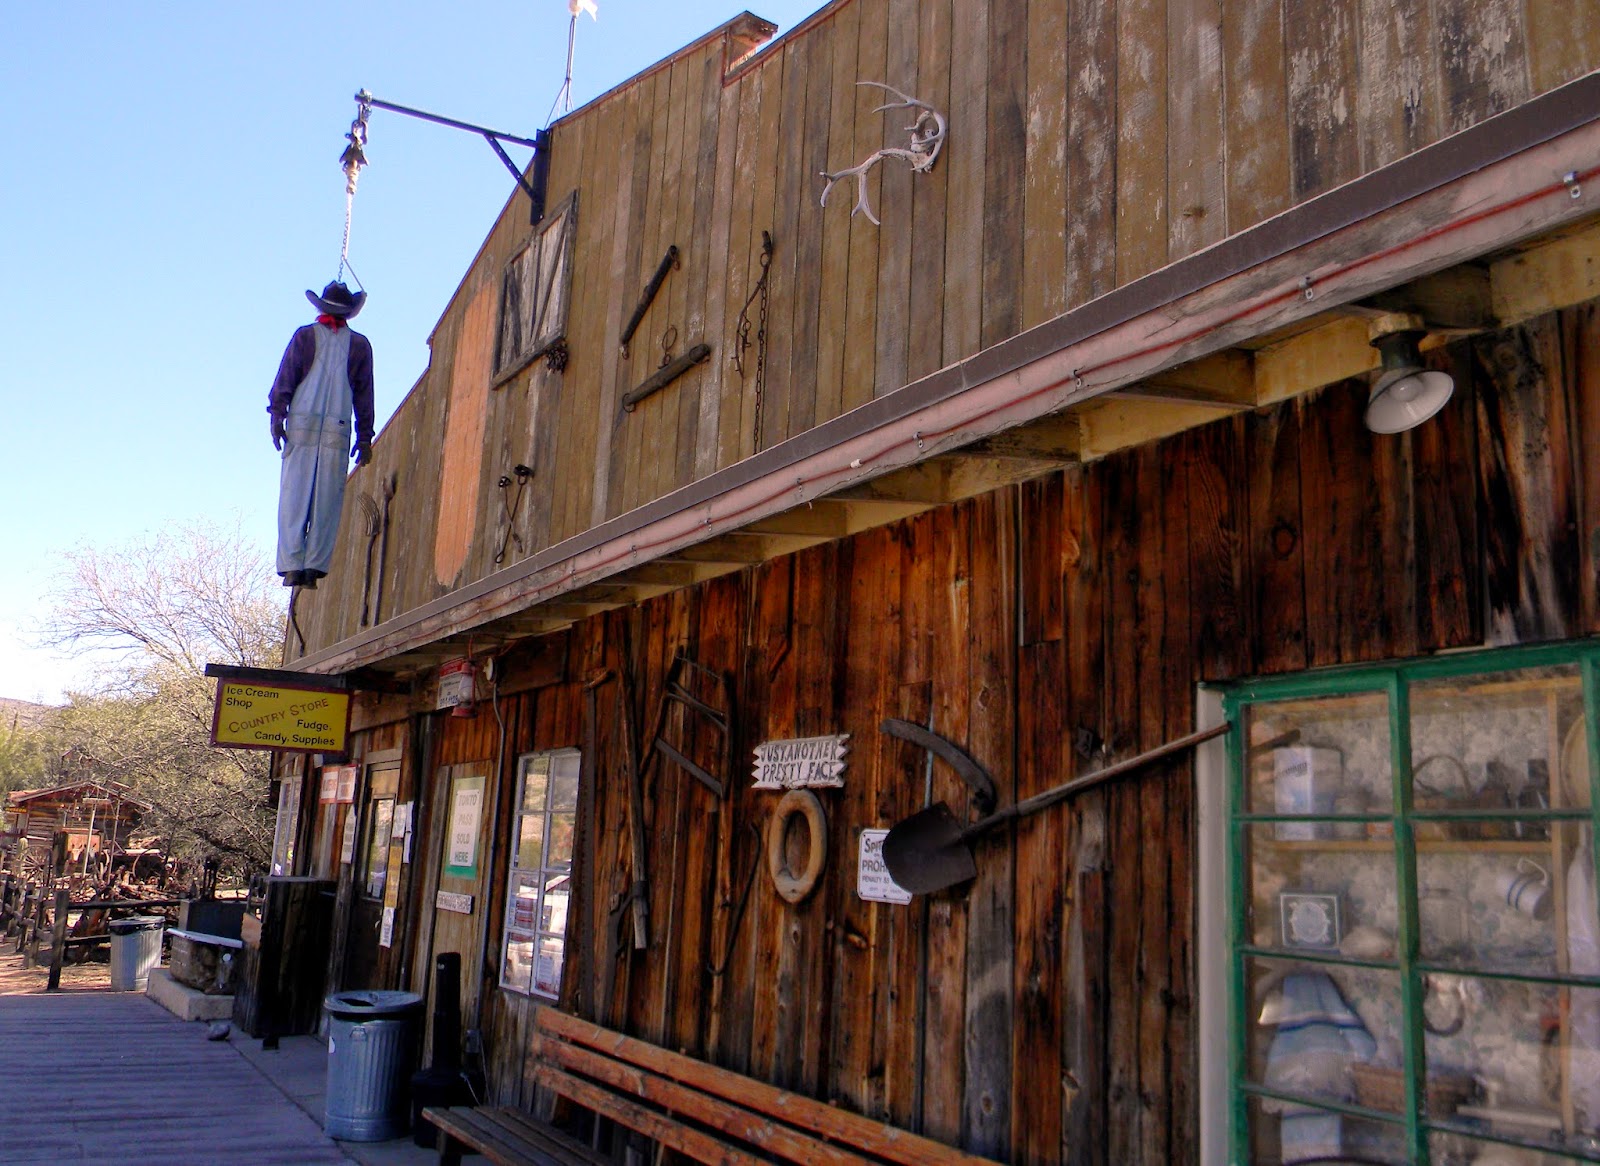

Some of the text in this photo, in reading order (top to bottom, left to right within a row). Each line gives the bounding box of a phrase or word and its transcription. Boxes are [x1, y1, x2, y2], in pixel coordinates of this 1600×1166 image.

[226, 686, 279, 699] Ice Cream
[225, 697, 253, 709] Shop
[292, 734, 335, 746] Supplies
[760, 740, 838, 762] JUST ANOTHER
[807, 761, 836, 782] FACE
[454, 851, 469, 863] HERE
